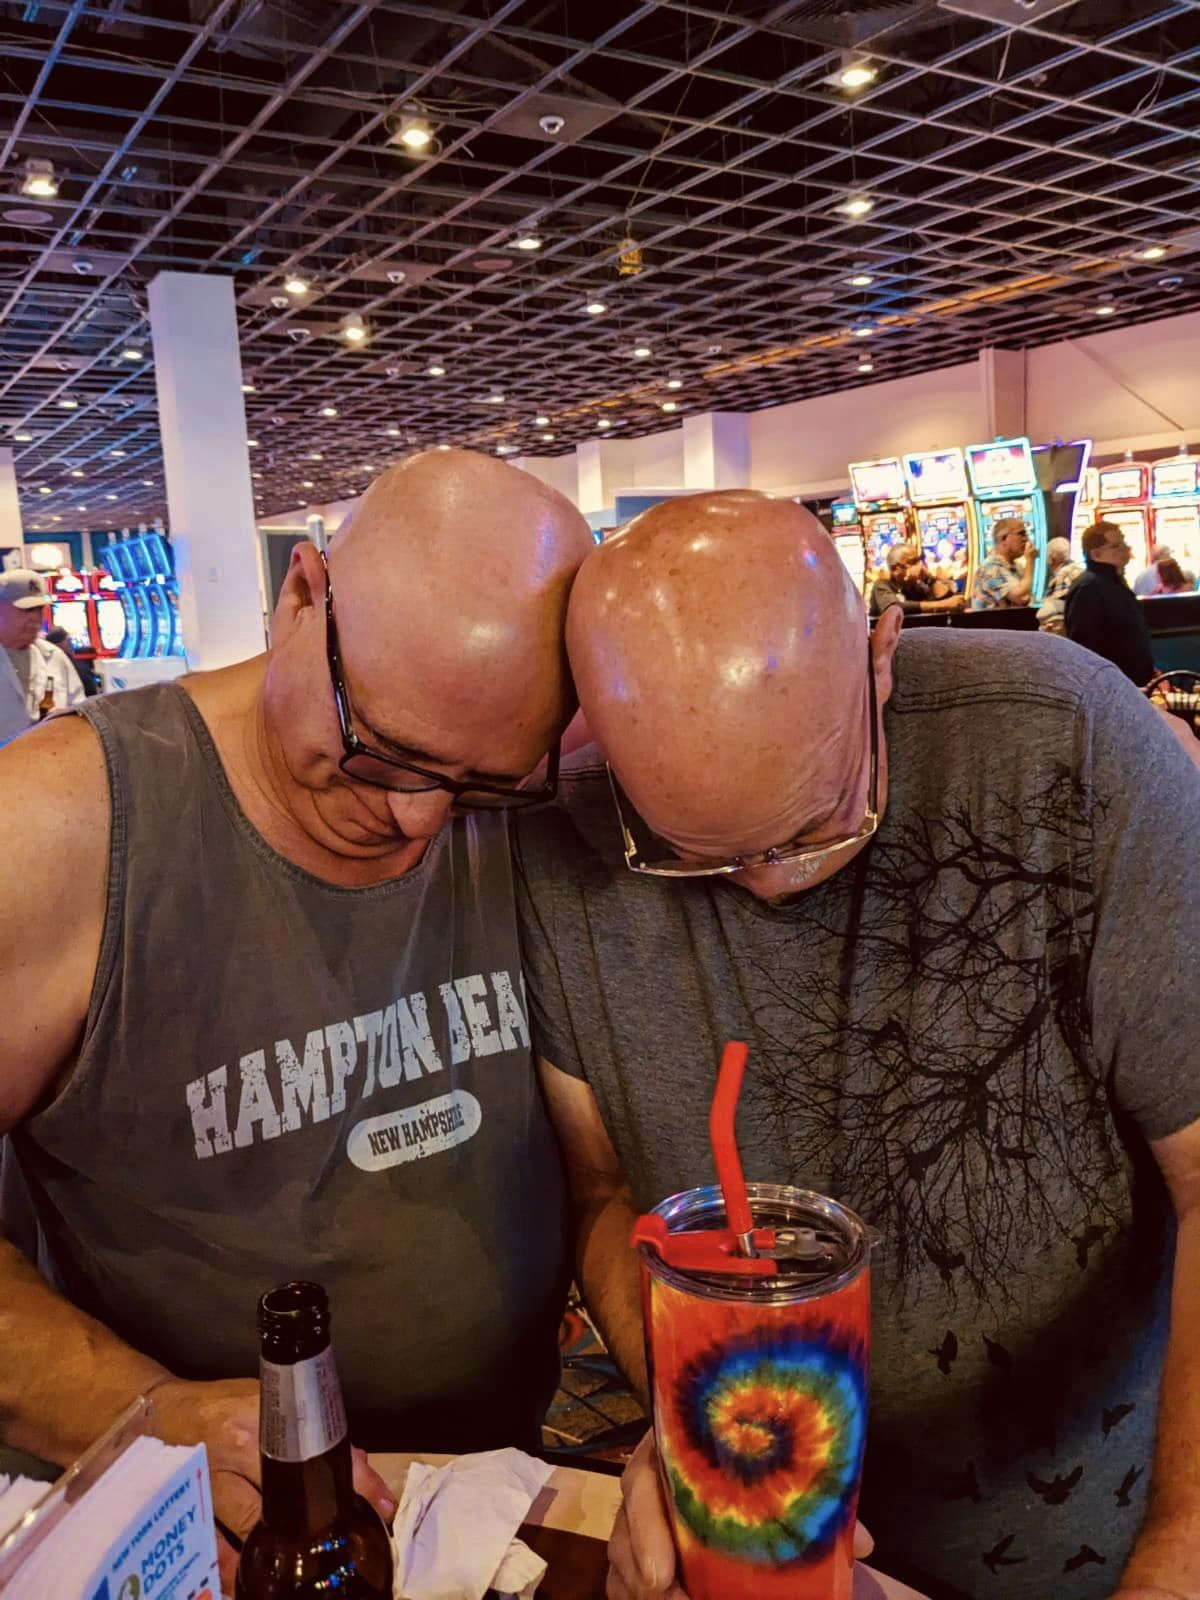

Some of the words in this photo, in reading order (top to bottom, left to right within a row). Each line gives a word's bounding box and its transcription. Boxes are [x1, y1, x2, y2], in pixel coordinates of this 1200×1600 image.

[185, 991, 443, 1160] HAMPTON
[367, 1125, 402, 1157] NEW
[153, 1478, 191, 1522] LOTTERY
[141, 1503, 197, 1575] MONEY
[143, 1539, 185, 1595] DOTS
